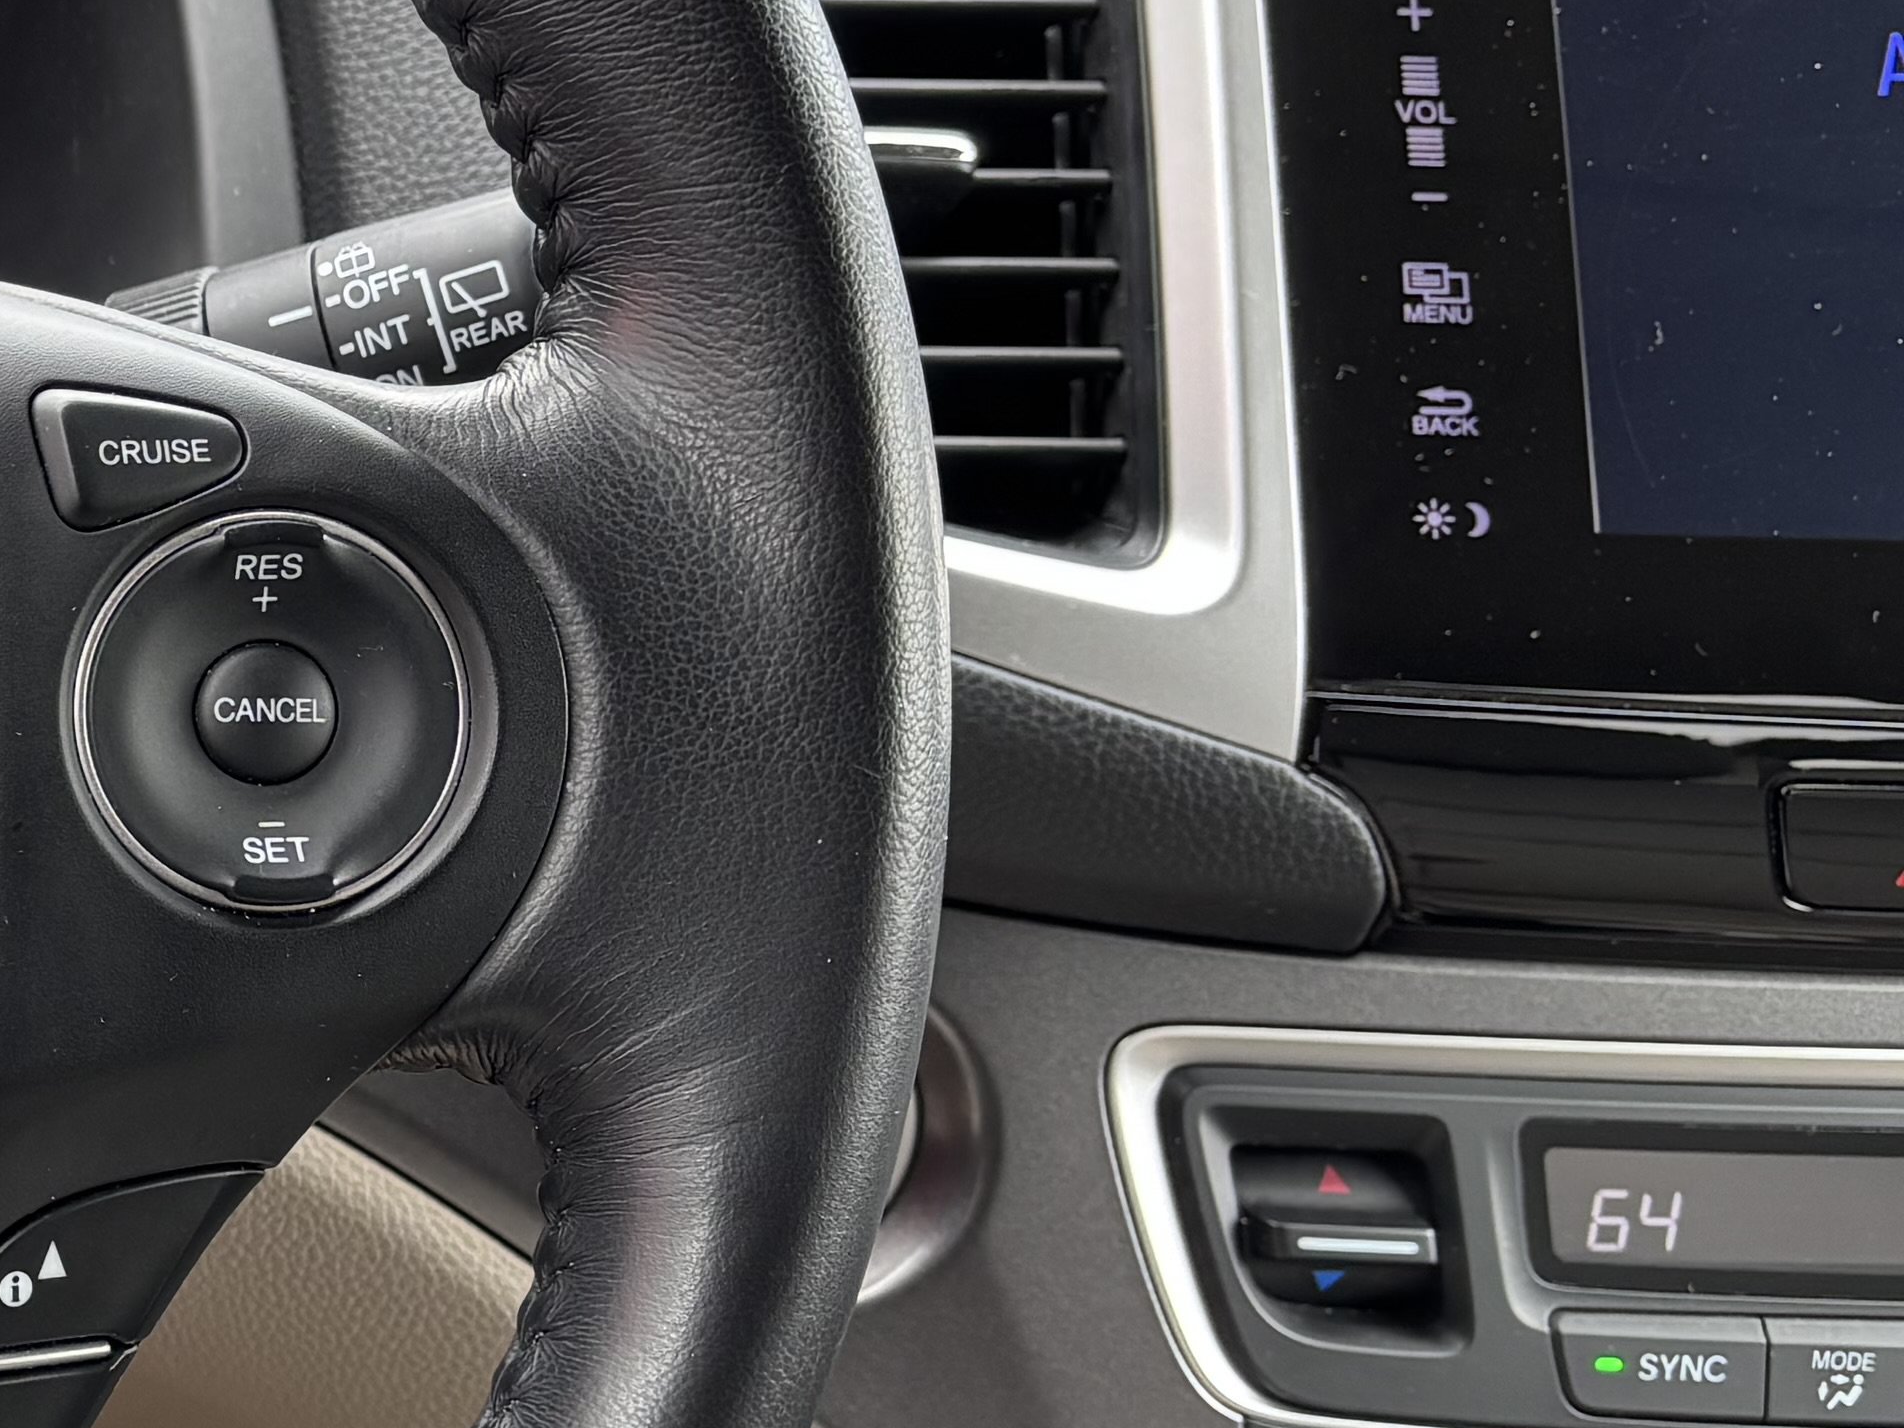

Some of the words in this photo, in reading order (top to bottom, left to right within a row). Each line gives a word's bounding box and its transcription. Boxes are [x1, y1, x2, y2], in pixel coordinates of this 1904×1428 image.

[1395, 101, 1457, 125] VOL
[342, 264, 410, 310] OFF
[1402, 304, 1474, 326] MENU
[353, 314, 411, 358] INT
[449, 310, 528, 352] REAR
[1411, 415, 1479, 438] BACK
[98, 437, 213, 467] CRUISE
[234, 552, 304, 582] RES
[213, 696, 327, 724] CANCEL
[242, 836, 310, 864] SET
[1586, 1188, 1683, 1253] 64
[1637, 1353, 1729, 1384] SYNC
[1811, 1350, 1877, 1372] MODE
